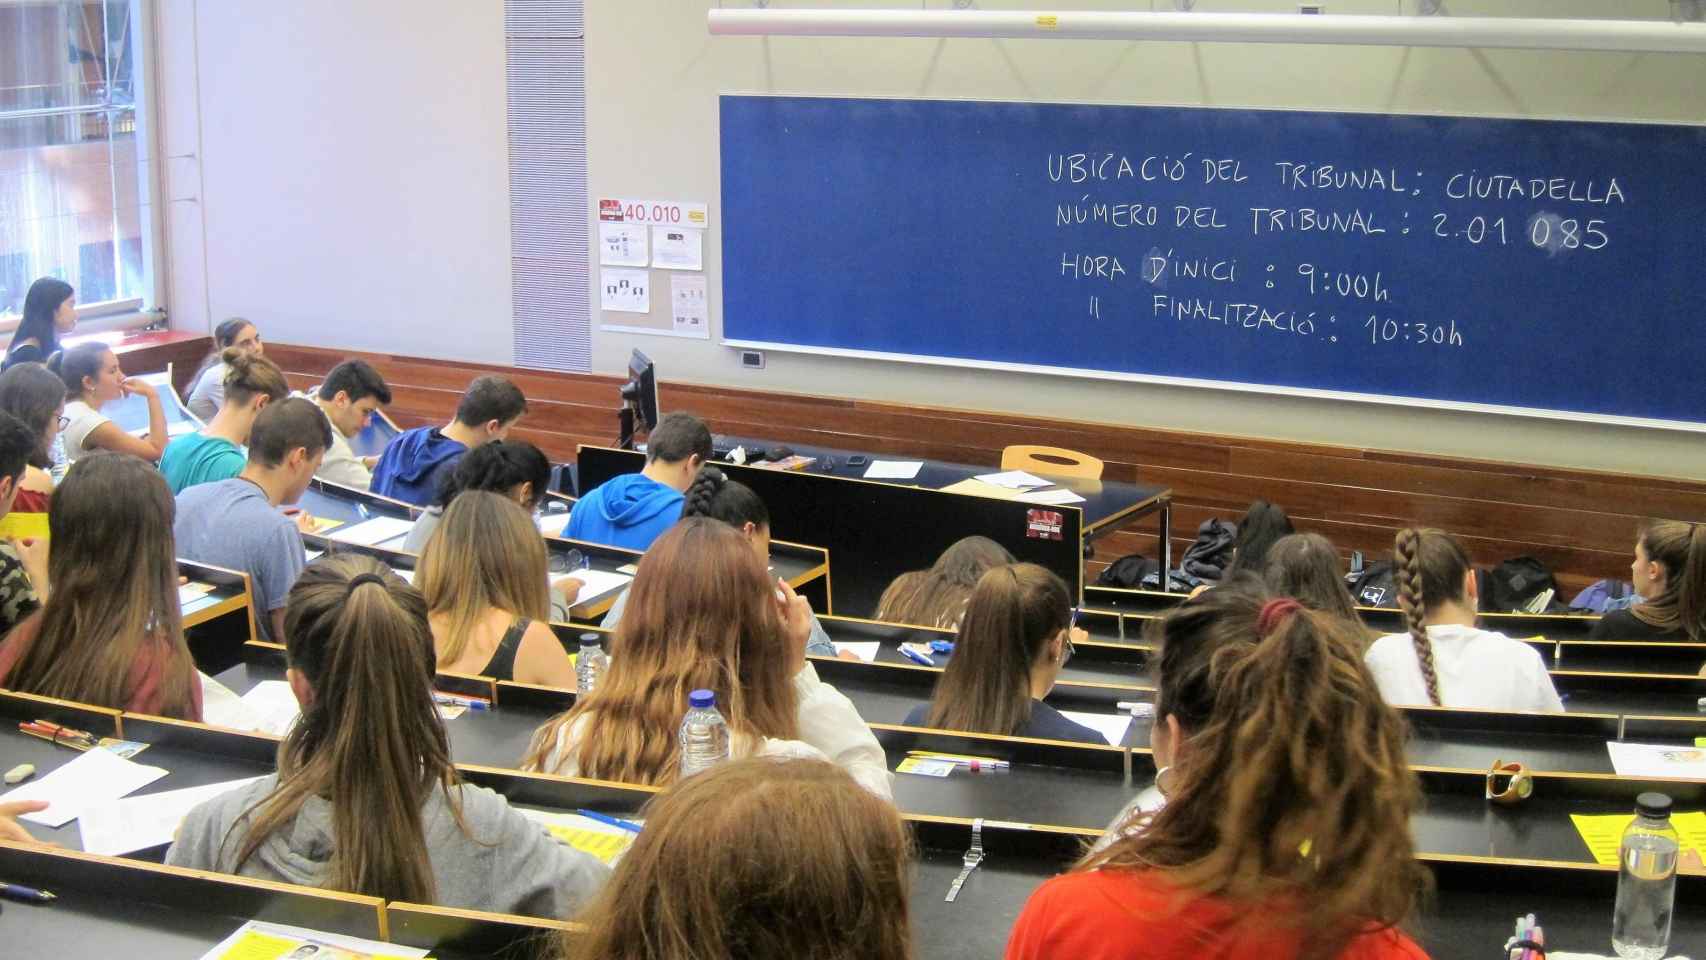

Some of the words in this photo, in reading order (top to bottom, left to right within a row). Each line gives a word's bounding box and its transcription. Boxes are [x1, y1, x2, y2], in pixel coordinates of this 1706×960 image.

[1048, 152, 1193, 183] UBICACIÓ
[1201, 159, 1249, 184] DEL
[1446, 169, 1625, 204] CIUTADELLA
[624, 203, 681, 223] 40.010
[1056, 194, 1157, 227] NÚMERO
[1175, 206, 1227, 228] DEL
[1061, 252, 1126, 280] HORA
[1298, 263, 1388, 301] 9:00h
[1364, 315, 1463, 346] 10:30h
